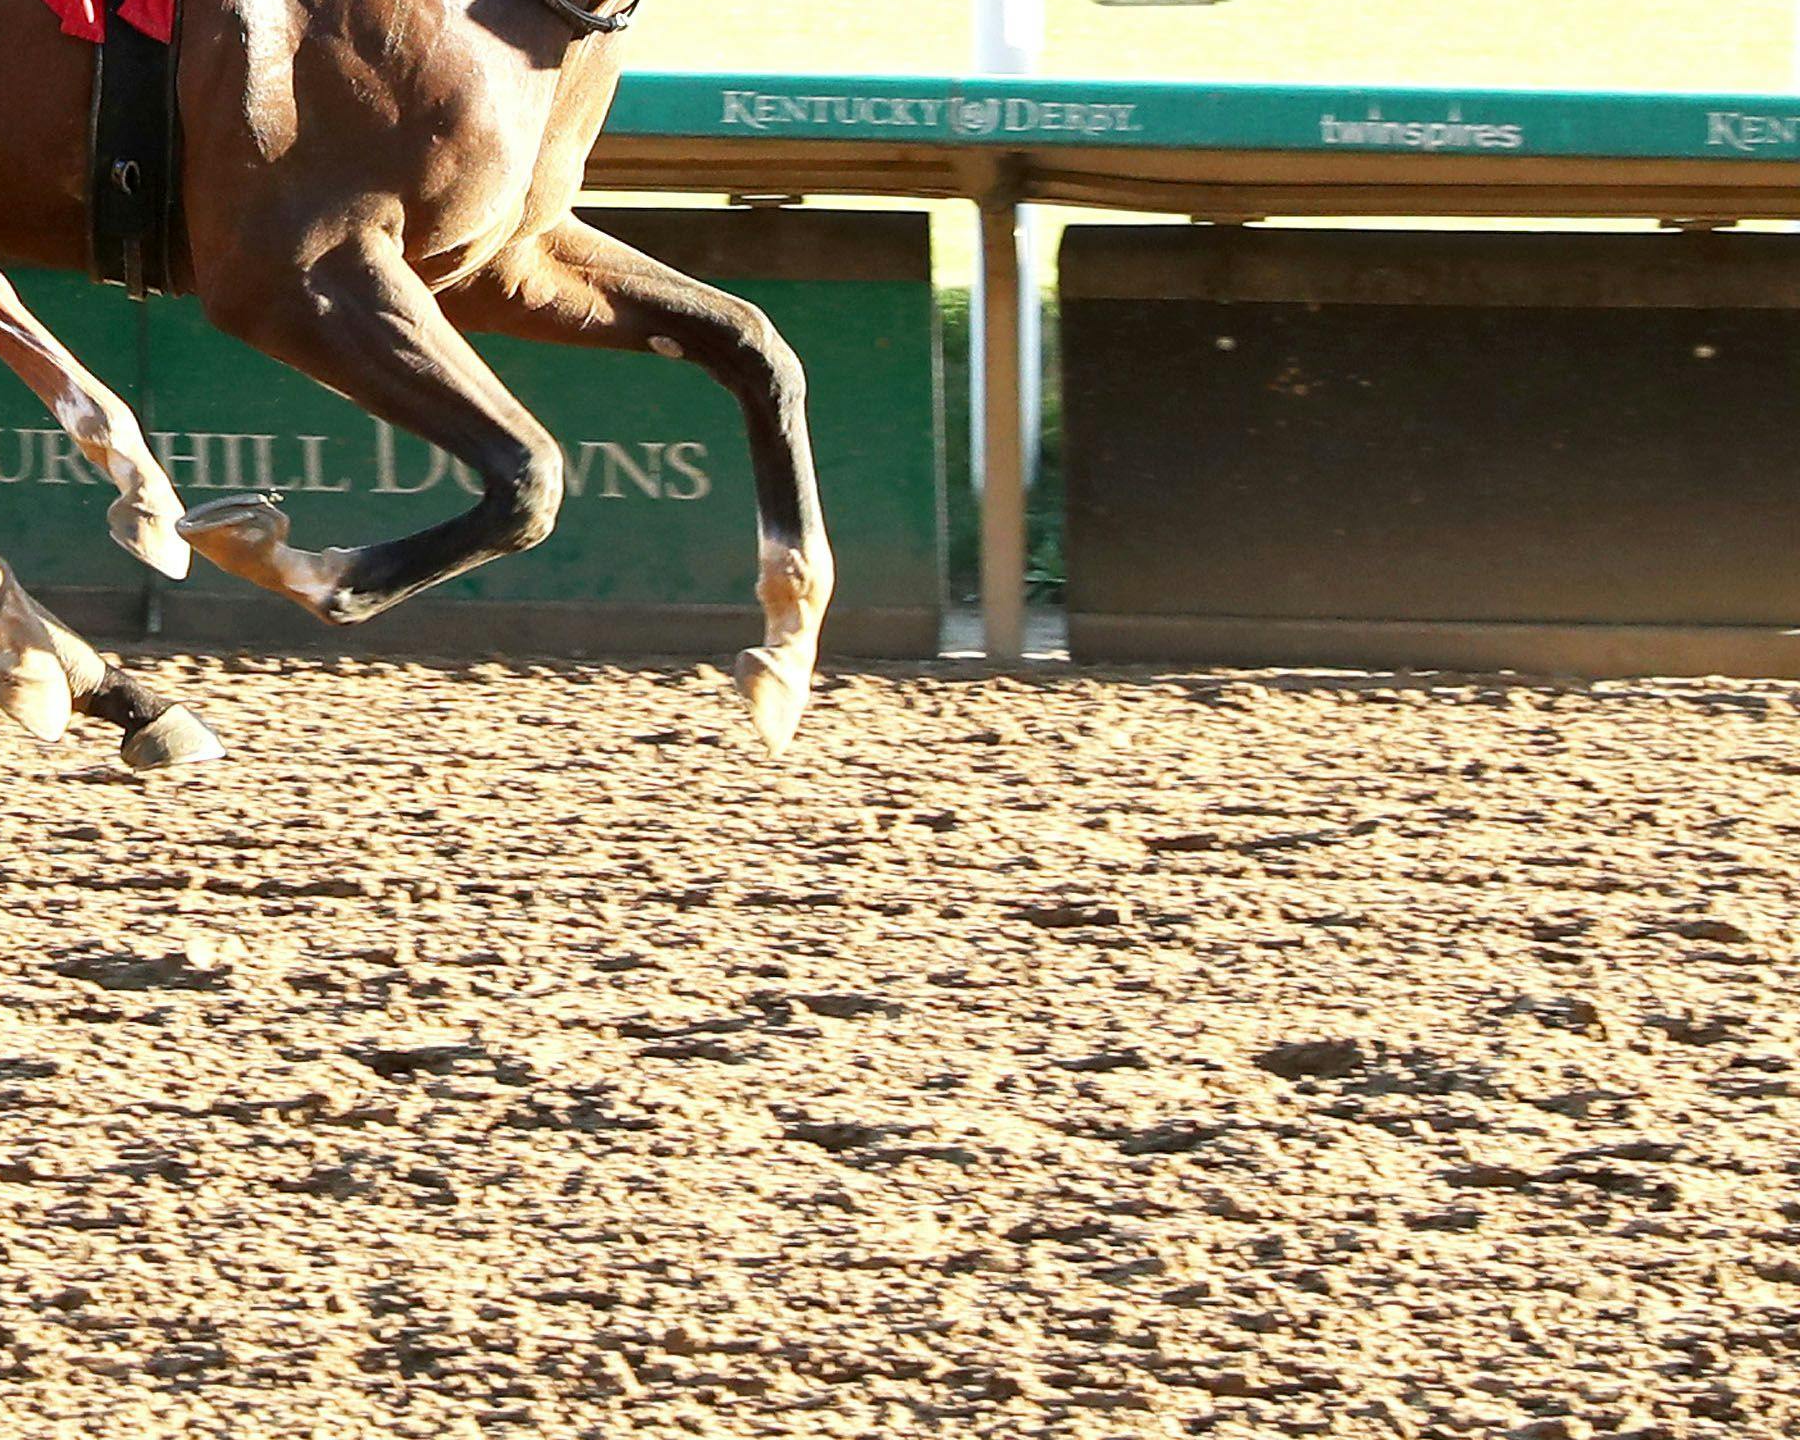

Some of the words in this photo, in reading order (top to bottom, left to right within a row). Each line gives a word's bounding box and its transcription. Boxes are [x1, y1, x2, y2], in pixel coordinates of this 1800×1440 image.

[720, 90, 945, 130] KENTUCKY
[1005, 97, 1143, 136] DERBY
[1320, 102, 1524, 152] twinspires
